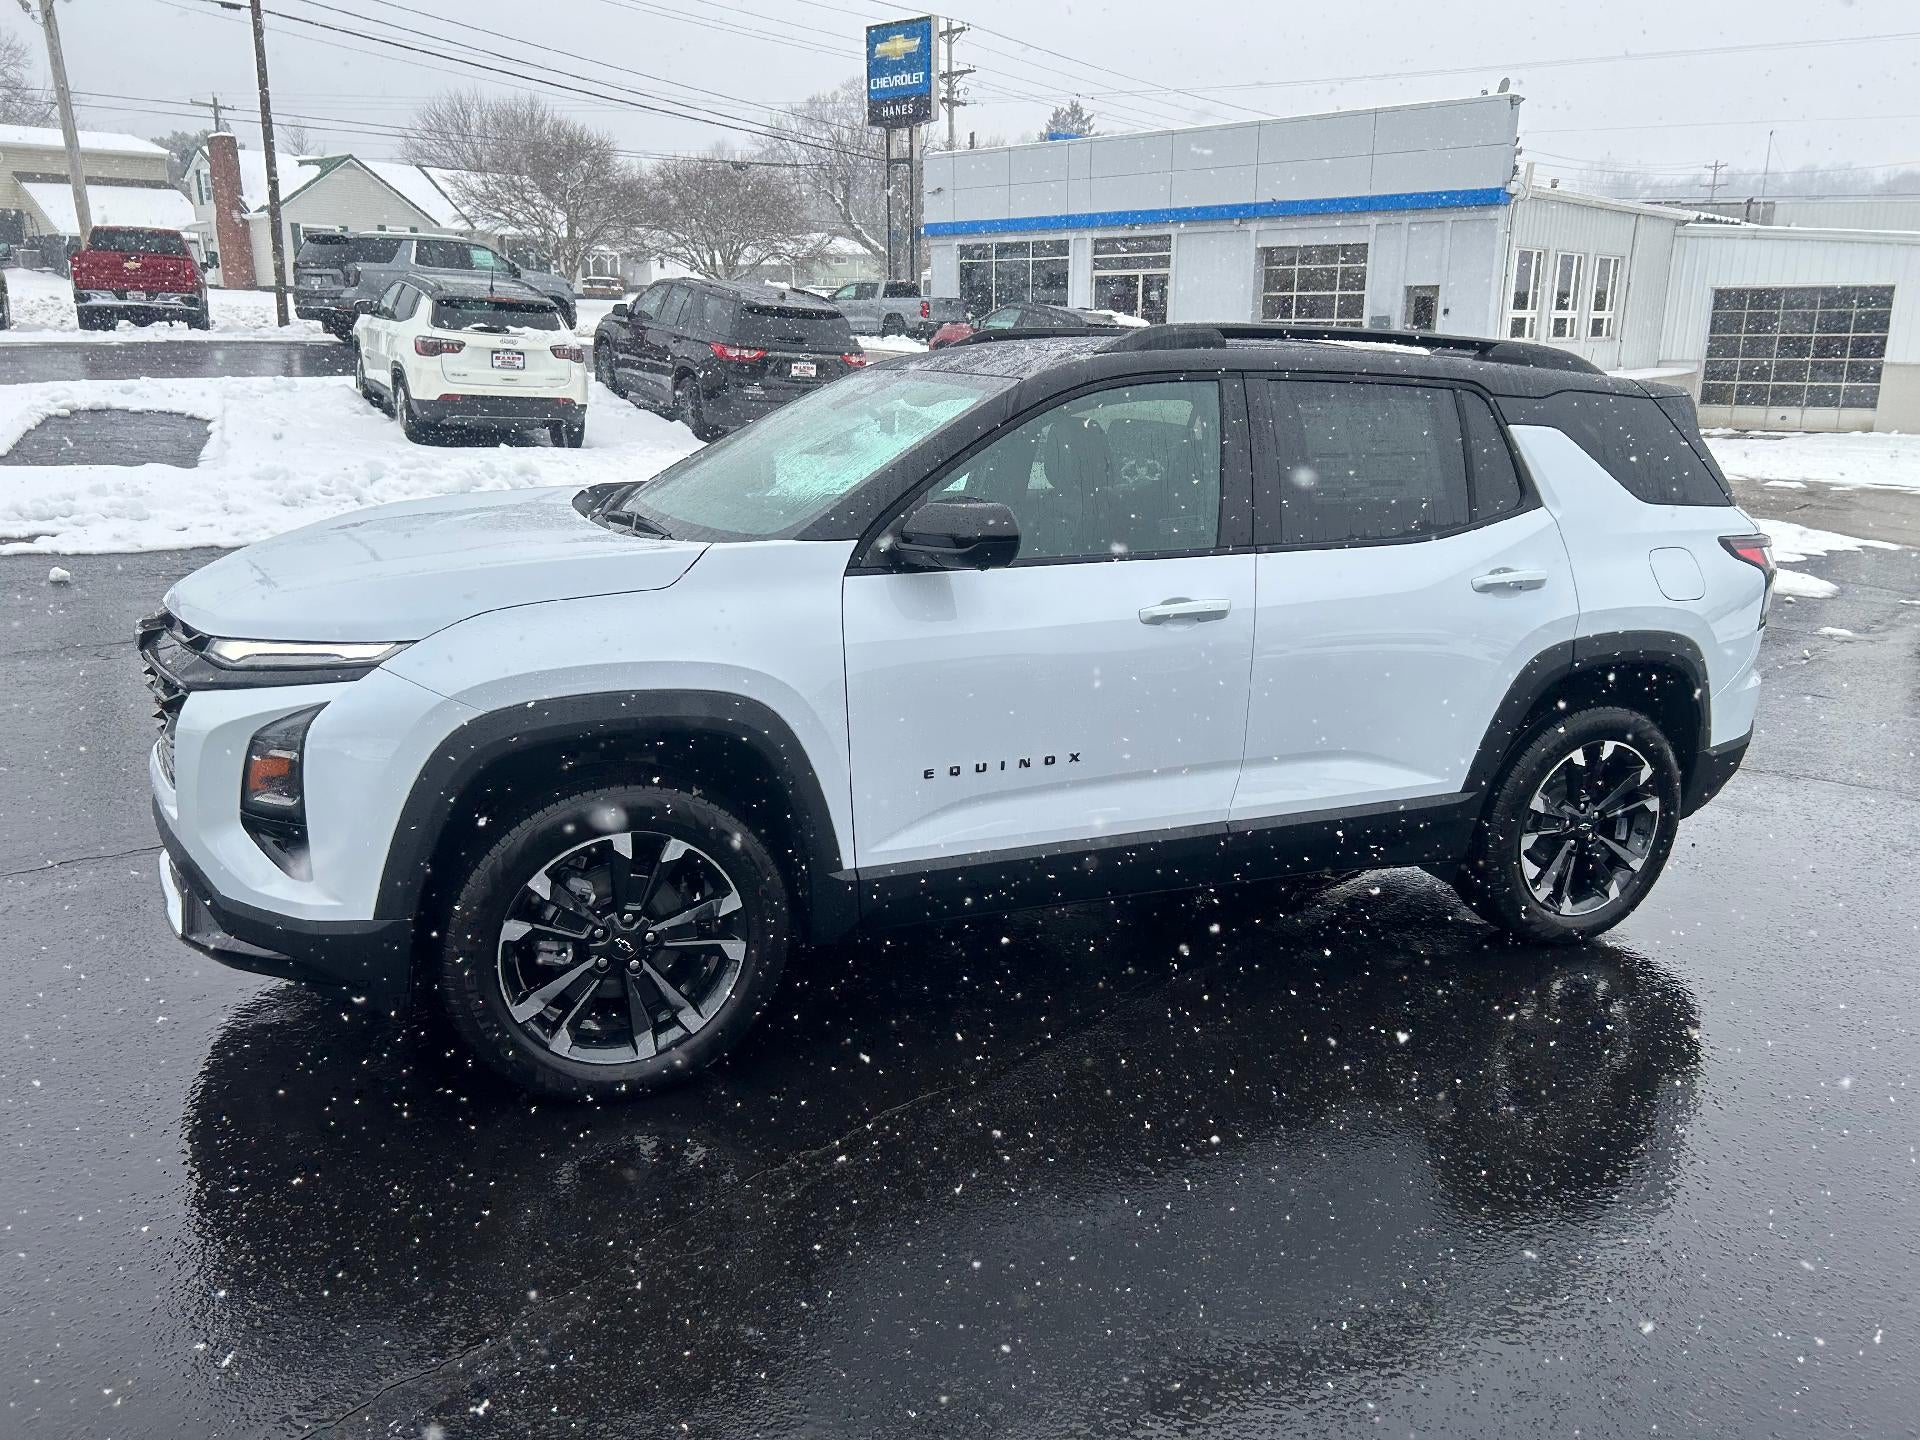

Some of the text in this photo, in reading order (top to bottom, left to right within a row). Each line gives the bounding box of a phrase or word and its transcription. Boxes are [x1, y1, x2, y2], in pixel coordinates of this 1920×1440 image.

[870, 72, 925, 90] CHEVROLET
[882, 104, 914, 117] HANES
[923, 752, 1081, 779] EQUINOX
